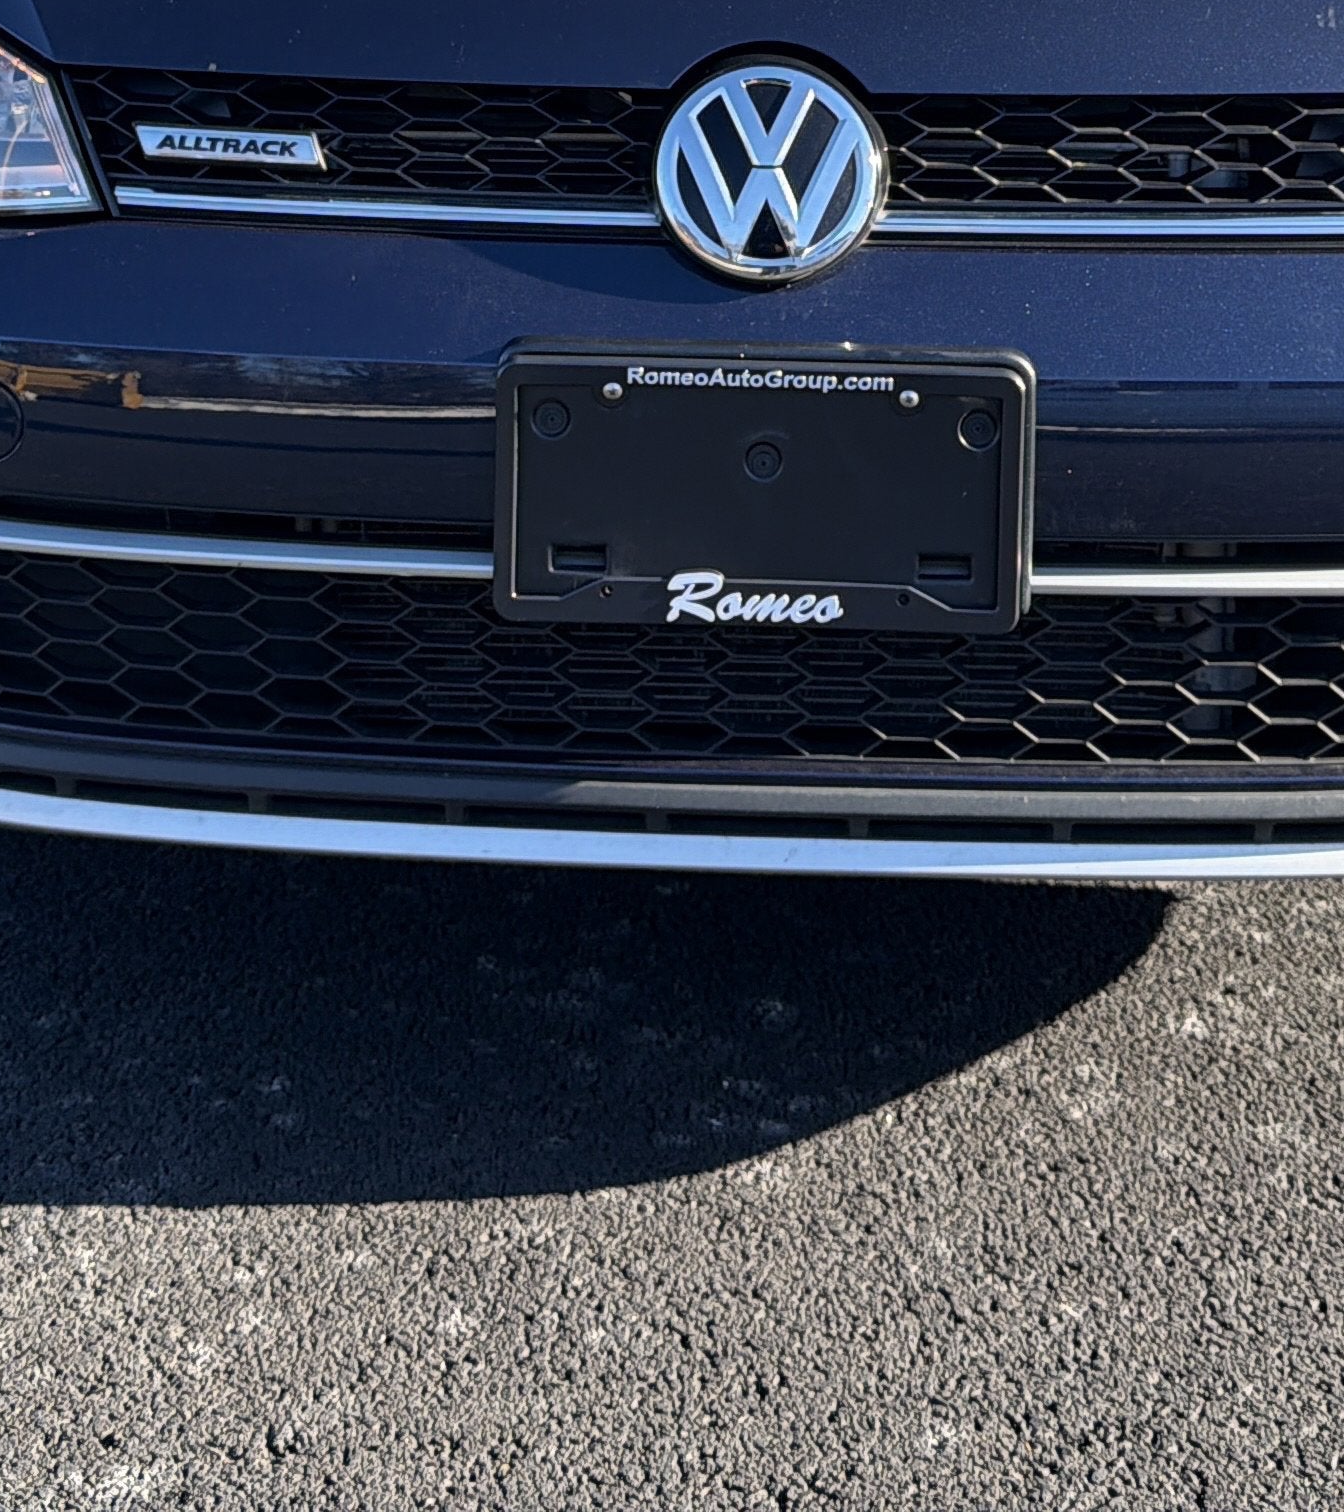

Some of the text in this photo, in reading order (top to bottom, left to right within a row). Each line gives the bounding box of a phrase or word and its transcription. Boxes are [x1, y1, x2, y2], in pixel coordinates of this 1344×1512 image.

[156, 134, 298, 157] ALLTRACK
[626, 366, 895, 393] RomeoAutoGroup.com
[666, 571, 844, 624] Romeo
